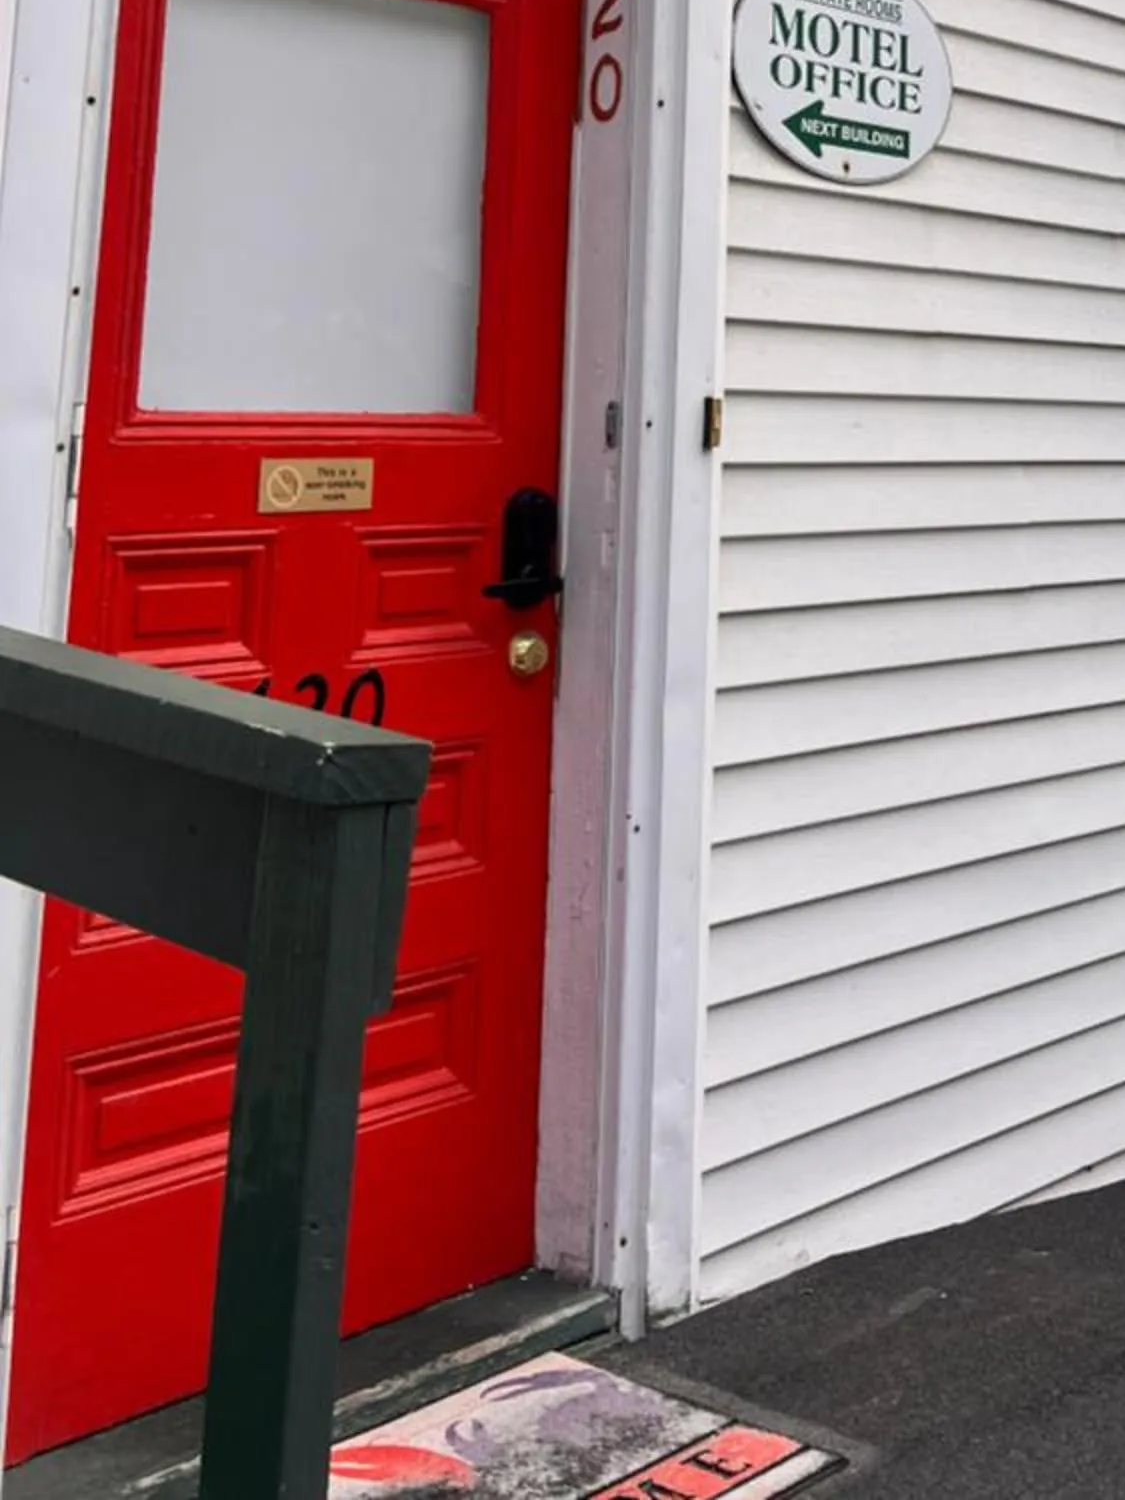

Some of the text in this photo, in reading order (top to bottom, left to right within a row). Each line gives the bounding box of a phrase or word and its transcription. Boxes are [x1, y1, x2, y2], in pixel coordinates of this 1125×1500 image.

[769, 3, 924, 77] MOTEL
[770, 54, 922, 114] OFFICE
[801, 118, 905, 150] NEXT BUILDING
